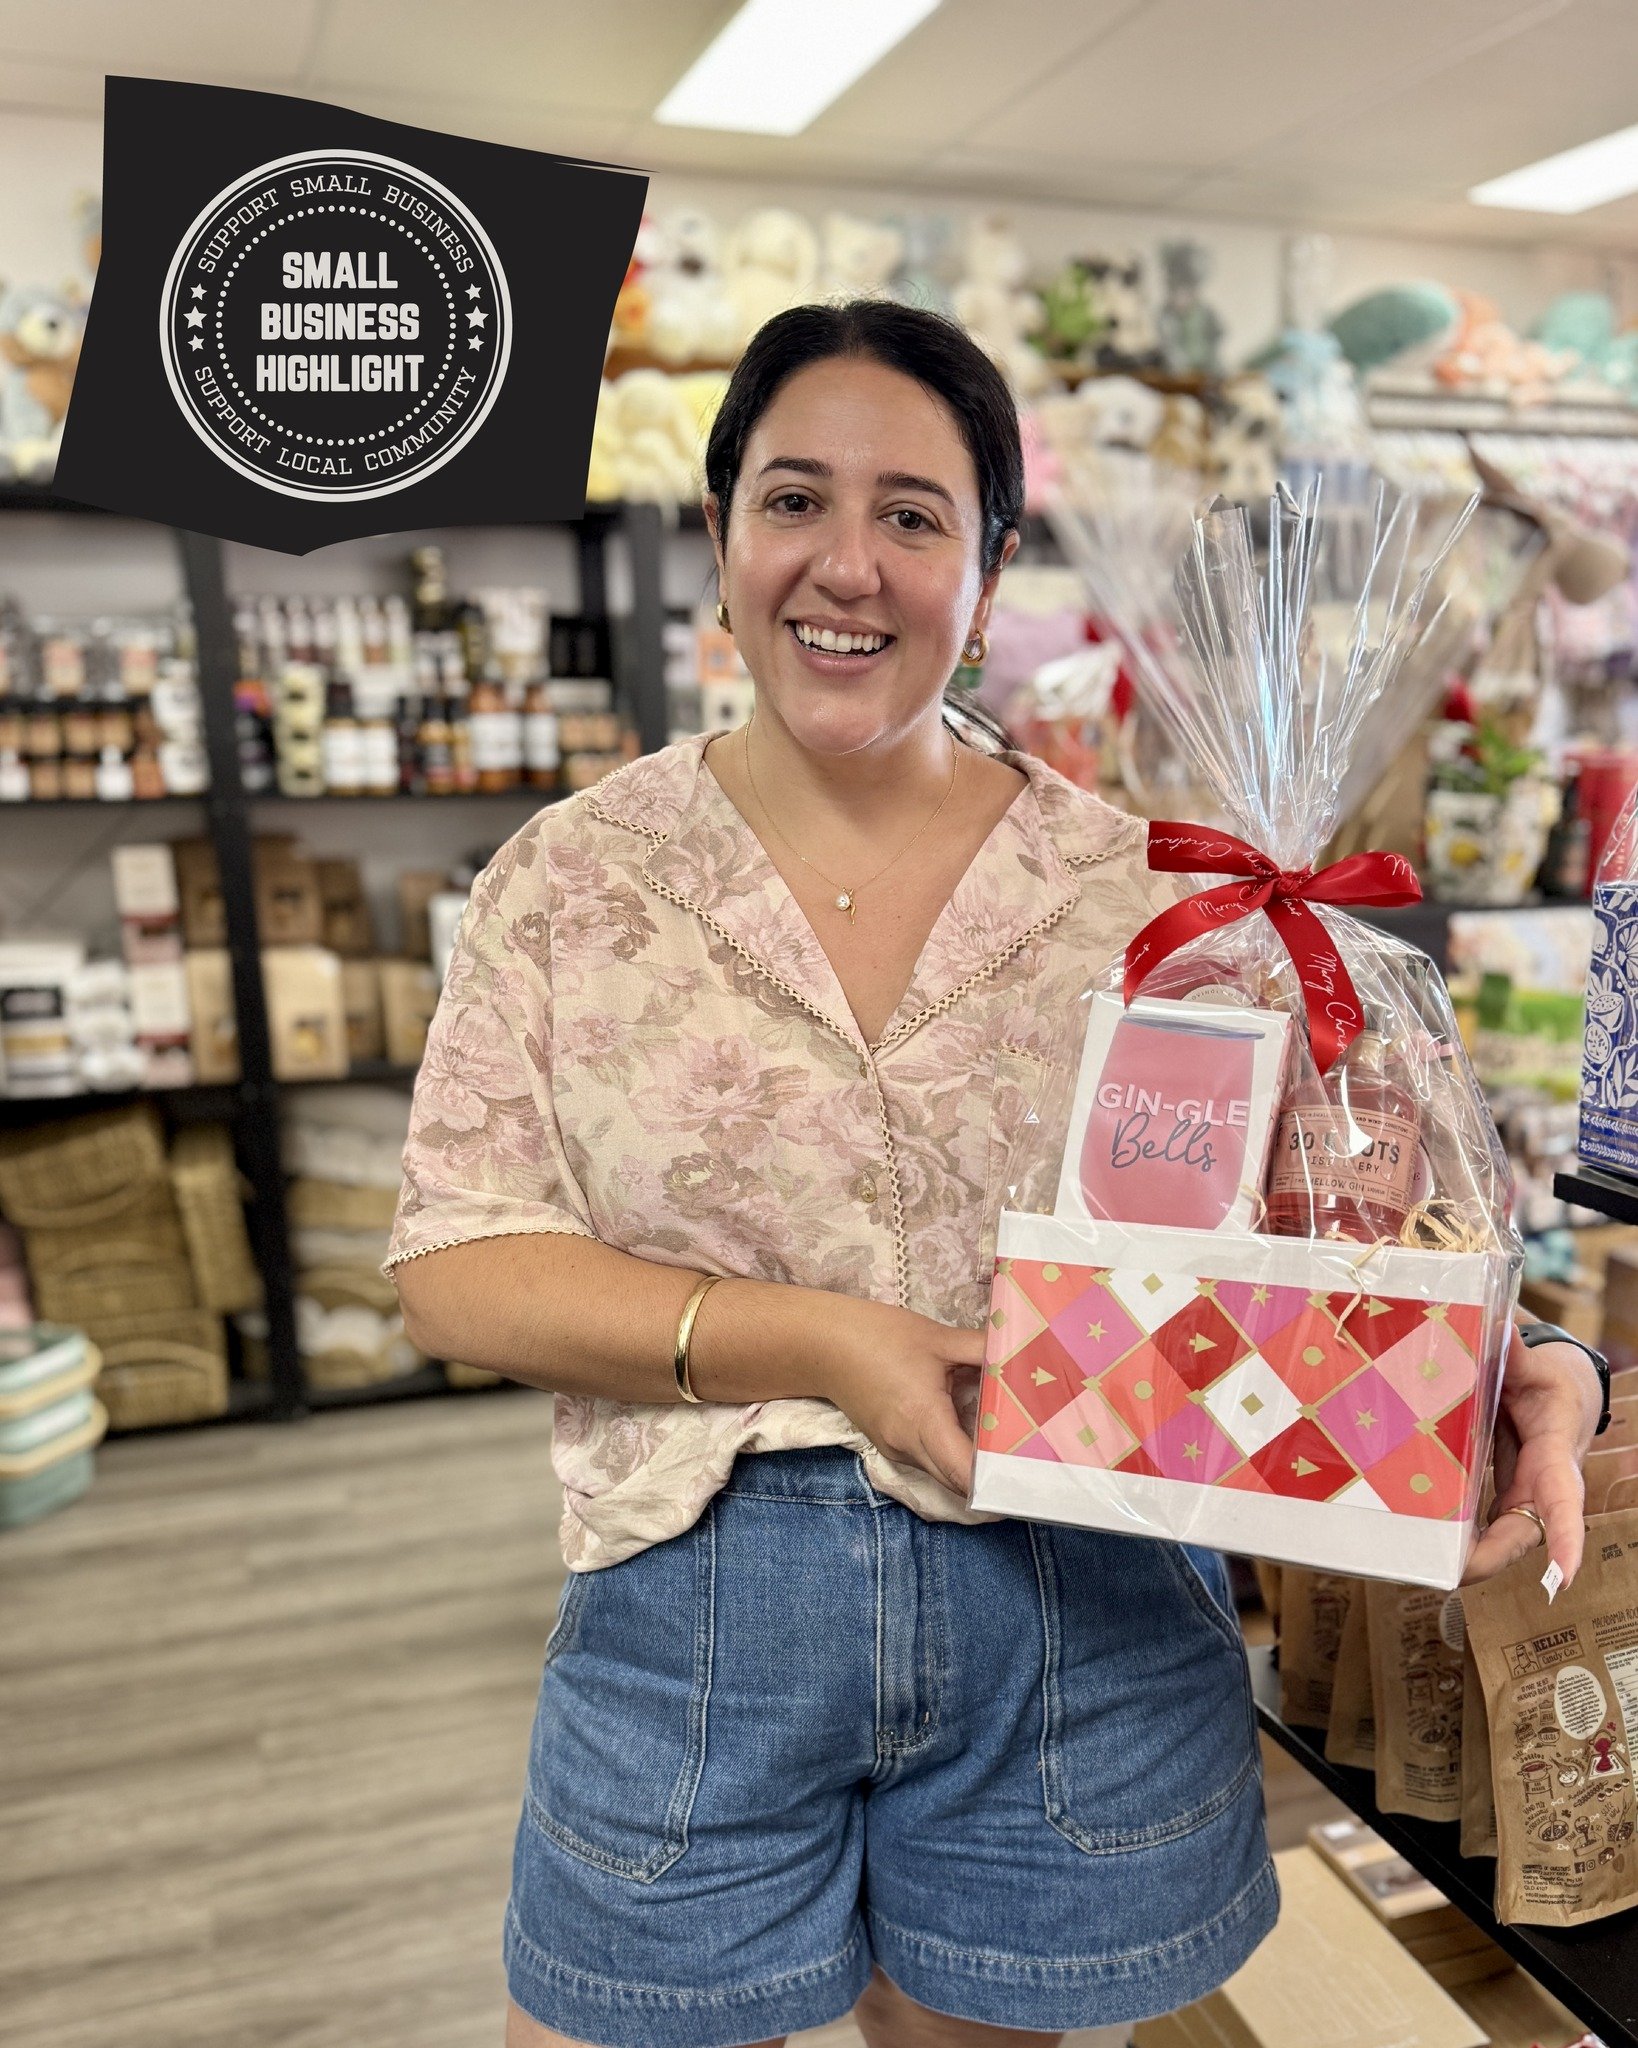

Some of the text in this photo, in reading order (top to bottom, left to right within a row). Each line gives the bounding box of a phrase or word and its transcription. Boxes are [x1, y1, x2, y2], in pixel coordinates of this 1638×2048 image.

[1188, 899, 1250, 919] Merry
[1304, 950, 1338, 997] Merry
[1096, 1083, 1250, 1128] GIN-GLE
[1111, 1112, 1219, 1173] Bells
[1289, 1131, 1315, 1151] 30
[1533, 1629, 1577, 1653] KELLYS
[1541, 1648, 1578, 1665] Candy Co.
